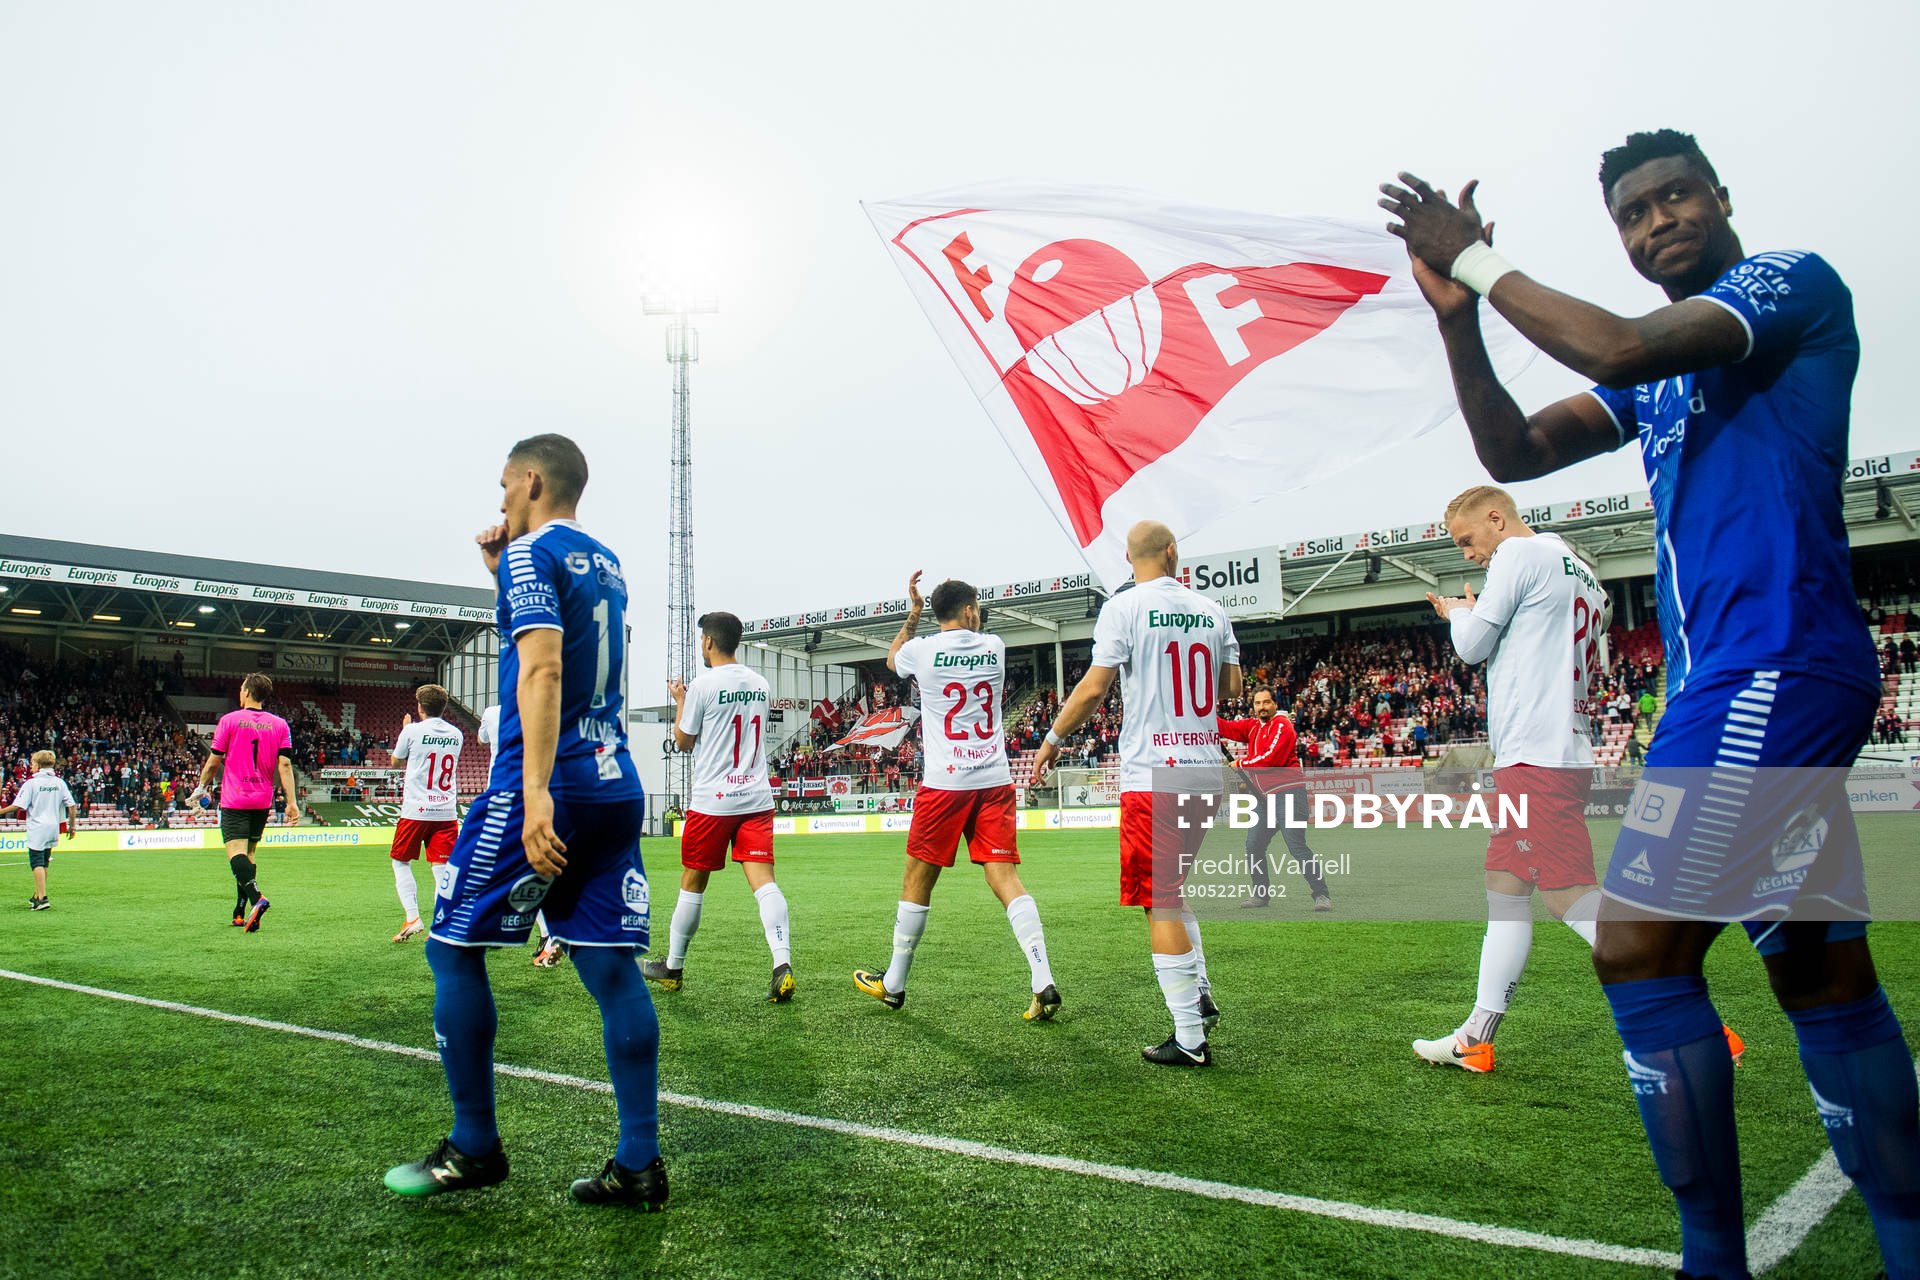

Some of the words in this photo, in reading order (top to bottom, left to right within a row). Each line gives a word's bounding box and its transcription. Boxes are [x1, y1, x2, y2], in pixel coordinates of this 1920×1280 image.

[1585, 495, 1630, 516] Solid
[1371, 528, 1409, 546] Solid
[1307, 538, 1343, 555] Solid
[0, 560, 51, 577] Europris
[68, 567, 117, 584] Europris
[1195, 557, 1260, 591] Solid
[132, 573, 180, 590] Europris
[194, 580, 239, 596] Europris
[1014, 581, 1042, 596] Solid
[1062, 574, 1091, 589] Solid
[253, 587, 295, 603] Europris
[308, 593, 348, 607] Europris
[361, 598, 399, 612] Europris
[411, 603, 447, 616] Europris
[459, 607, 493, 620] Europris
[843, 605, 866, 620] Solid
[883, 599, 907, 614] Solid
[769, 616, 790, 629] Solid
[805, 611, 827, 624] Solid
[1149, 609, 1215, 633] Europris
[345, 660, 388, 670] Demokraten
[394, 663, 435, 673] Demokraten
[934, 651, 998, 670] Europris
[1165, 640, 1214, 718] 10
[718, 688, 767, 705] Europris
[943, 681, 994, 741] 23
[421, 734, 459, 748] Europris
[731, 714, 761, 769] 11
[251, 738, 259, 772] 1
[427, 752, 454, 791] 18
[138, 833, 196, 845] kynningsrud
[1622, 868, 1656, 886] SELECT
